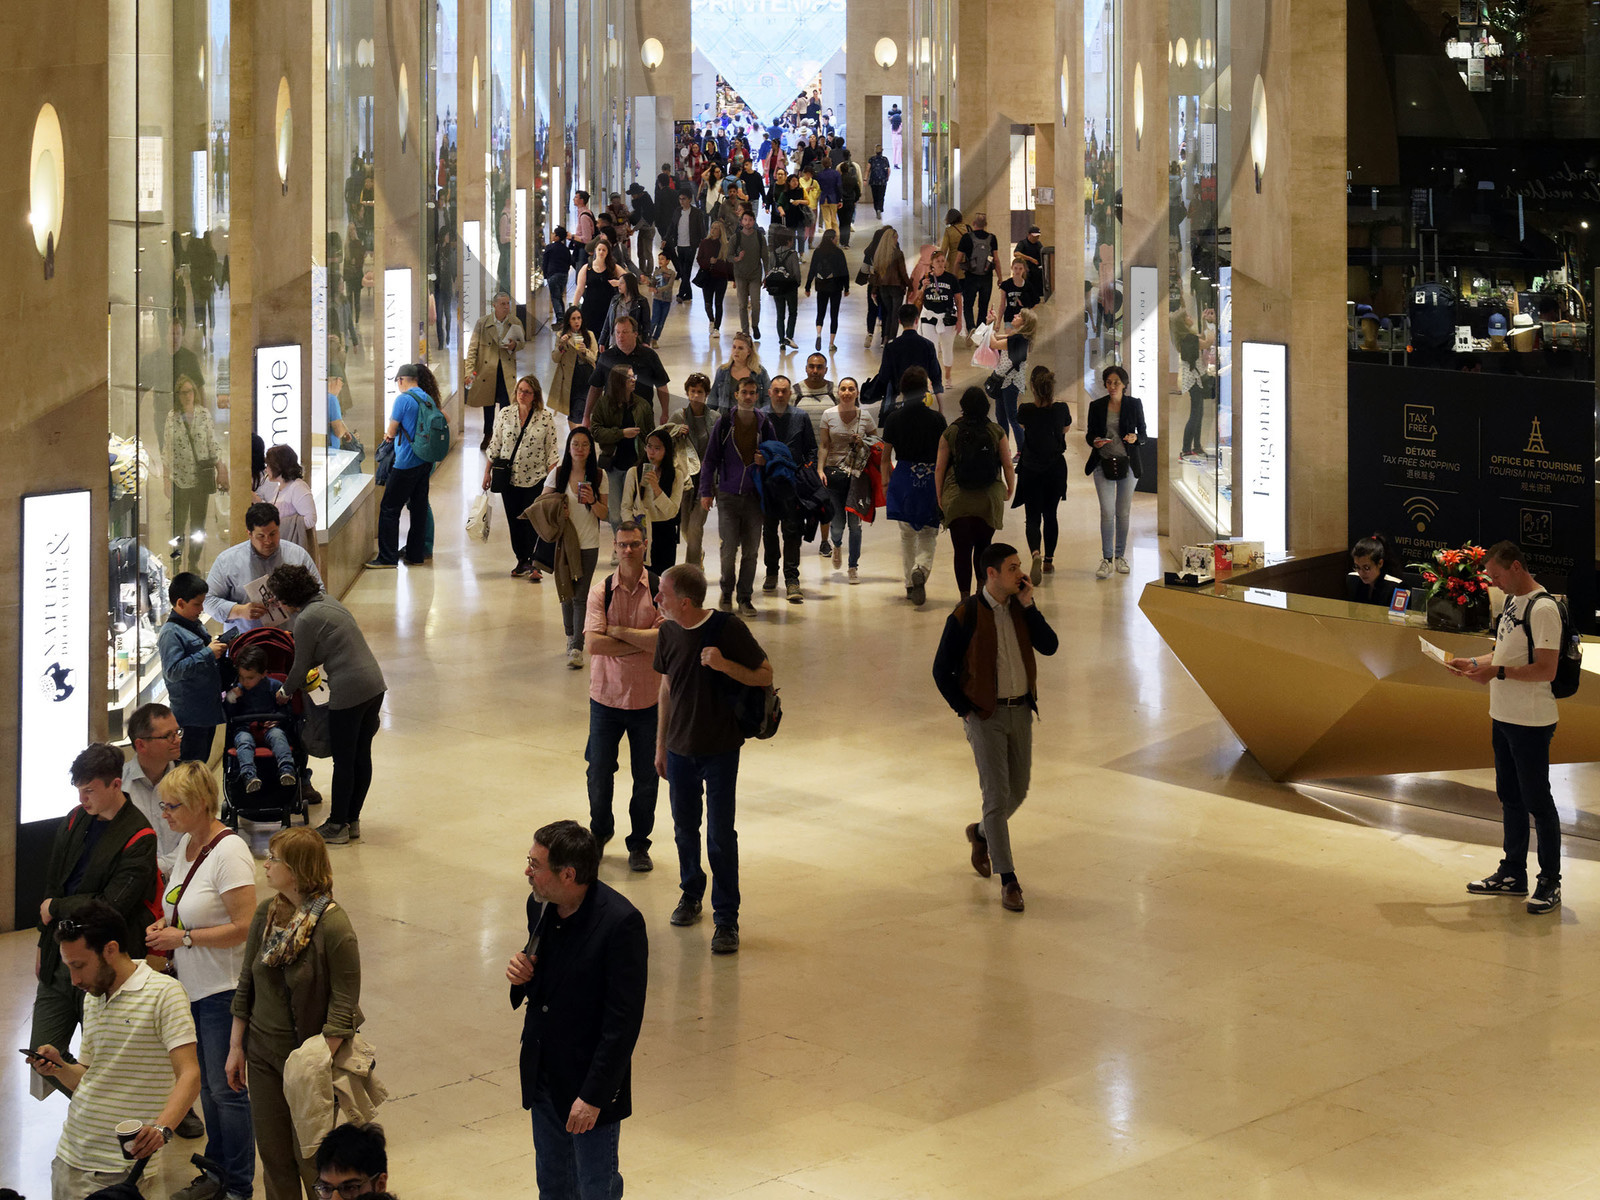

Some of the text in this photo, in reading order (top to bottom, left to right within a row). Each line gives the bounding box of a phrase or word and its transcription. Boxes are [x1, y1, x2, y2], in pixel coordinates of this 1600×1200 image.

[267, 360, 293, 448] maje
[1408, 412, 1428, 424] TAX
[1253, 369, 1275, 496] Fragonard
[1408, 423, 1428, 433] FREE
[1405, 446, 1437, 458] DÉTAXE
[1382, 455, 1461, 472] TAX FREE SHOPPING
[1490, 455, 1583, 473] OFFICE DE TOURISME
[1488, 466, 1586, 485] TOURISM INFORMATION
[1394, 536, 1449, 550] WIFI GRATUIT
[1402, 548, 1422, 559] FREE
[44, 532, 70, 657] NATURE &
